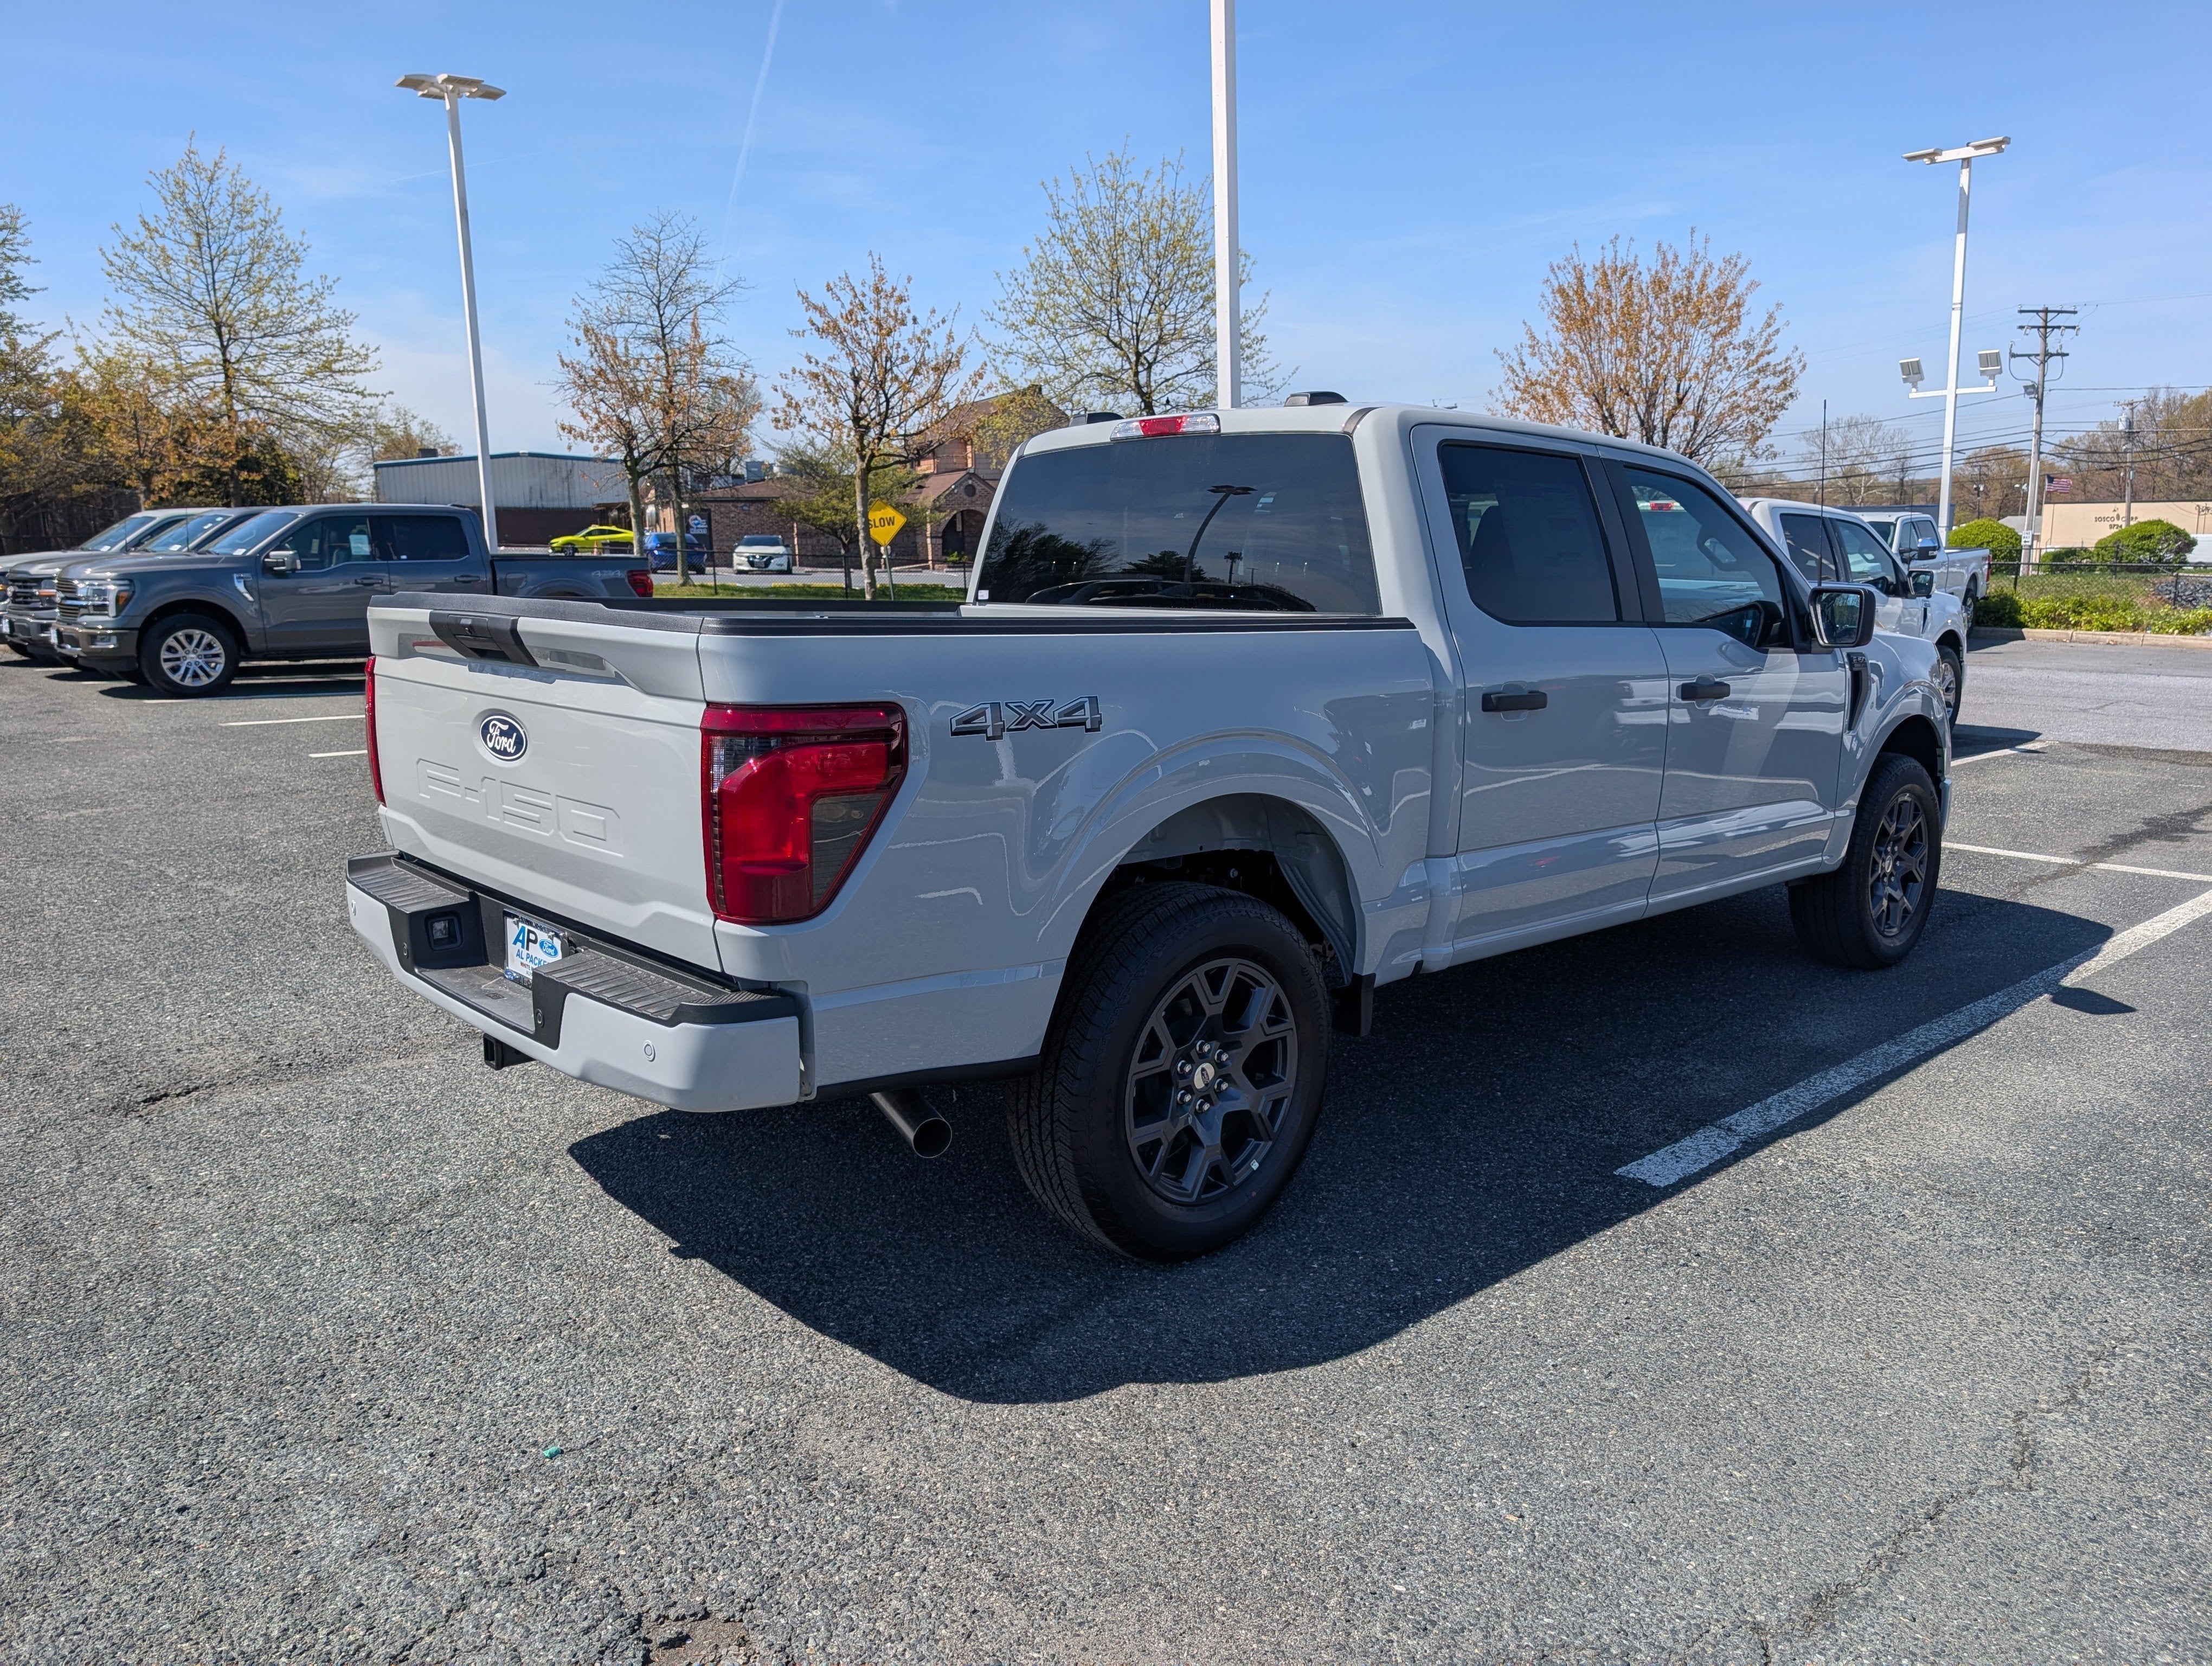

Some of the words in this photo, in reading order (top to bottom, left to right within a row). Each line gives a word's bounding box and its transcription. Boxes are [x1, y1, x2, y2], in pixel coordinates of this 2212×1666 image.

[869, 516, 896, 530] SLOW
[486, 720, 517, 753] Ford
[416, 758, 624, 857] F-150
[512, 925, 538, 952] AP
[542, 941, 556, 955] Ford
[516, 949, 524, 960] AL
[525, 952, 548, 967] PACKE
